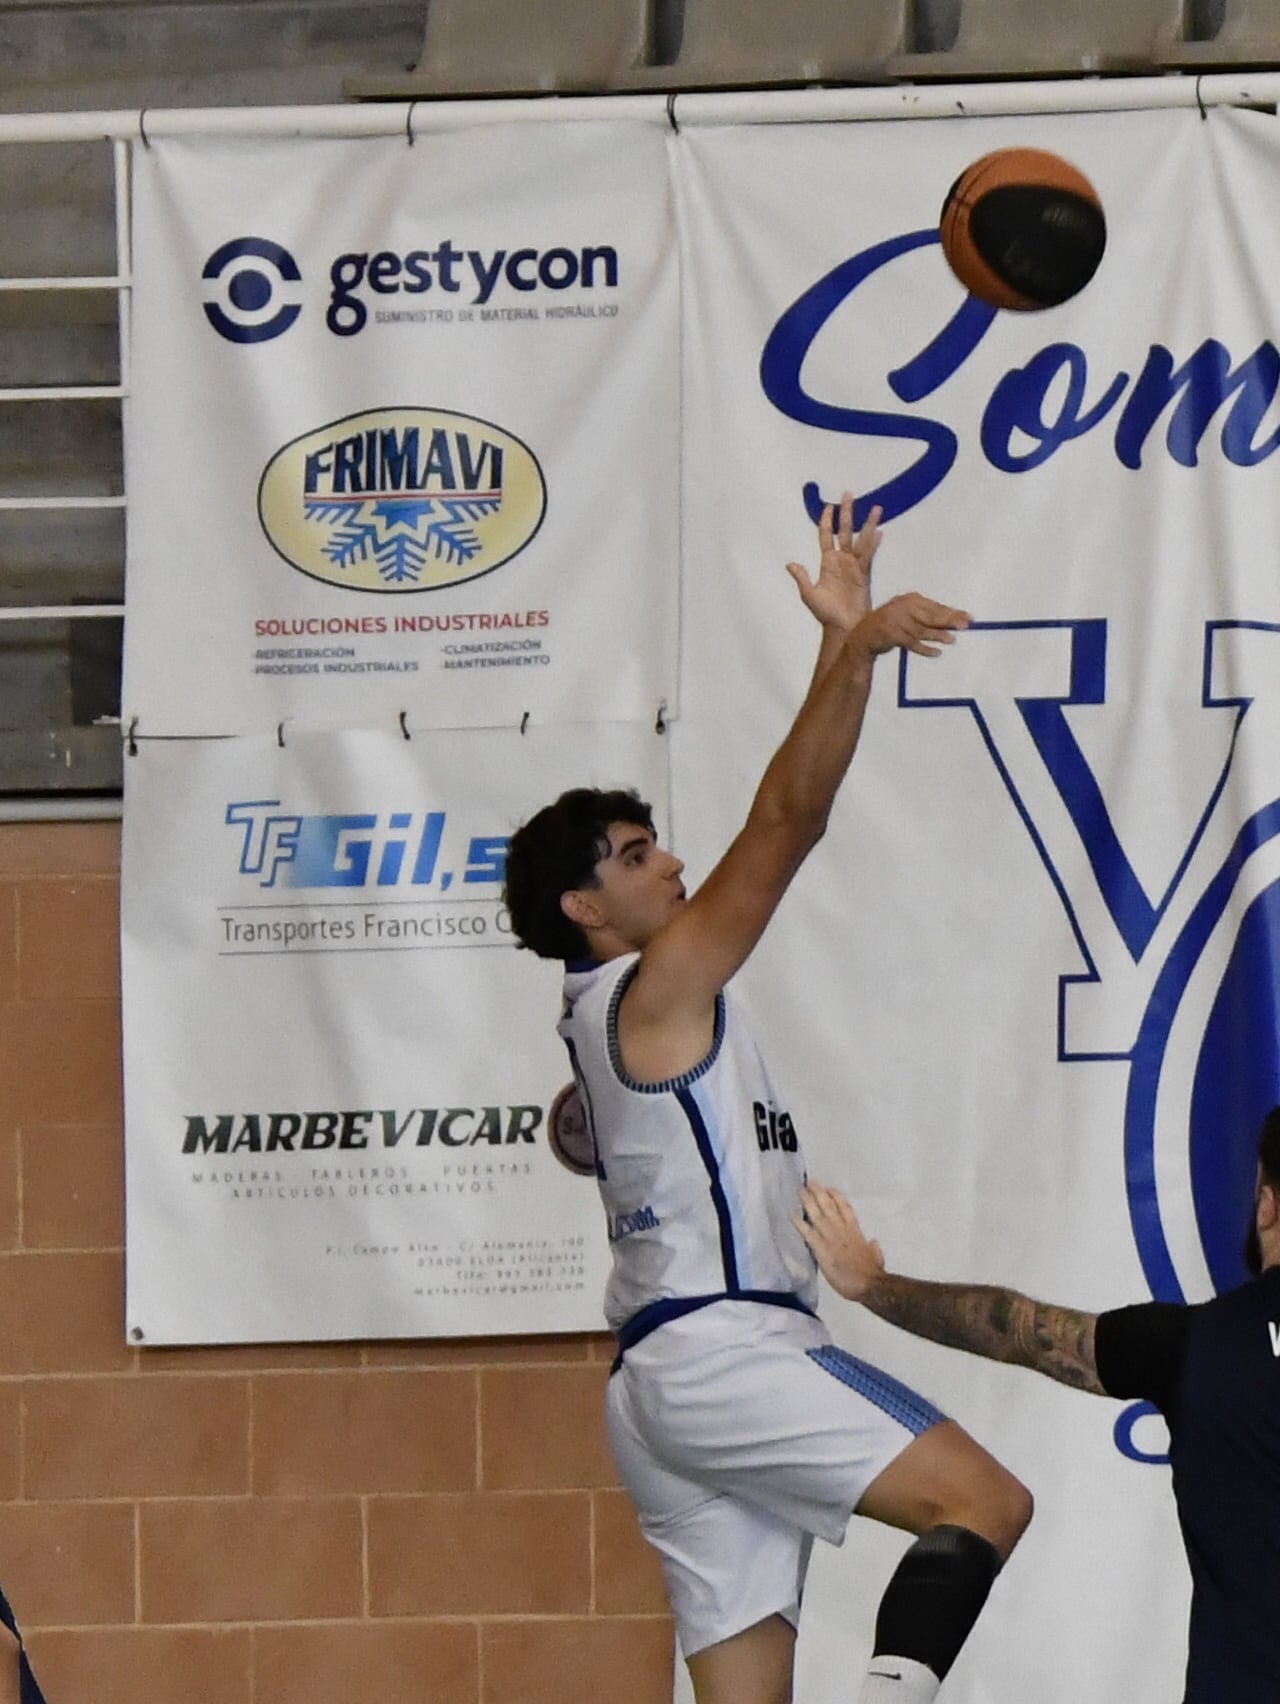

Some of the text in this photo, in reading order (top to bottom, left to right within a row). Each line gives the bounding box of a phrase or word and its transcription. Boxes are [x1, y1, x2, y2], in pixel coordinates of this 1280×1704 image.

[326, 240, 618, 336] gestycon
[375, 310, 454, 323] SUMINISTRO
[458, 311, 474, 322] DE
[481, 307, 539, 321] MATERIAL
[304, 427, 504, 493] FRIMAVI
[255, 610, 550, 637] SOLUCIONES INDUSTRIALES
[324, 660, 419, 673] INDUSTRIALES
[221, 917, 355, 945] Transportes
[364, 912, 487, 938] Francisco
[182, 1105, 544, 1155] MARBEVICAR
[192, 1162, 532, 1184] MADERAS TABLEROS PUERTAS
[350, 1182, 496, 1197] DECORATIVOS
